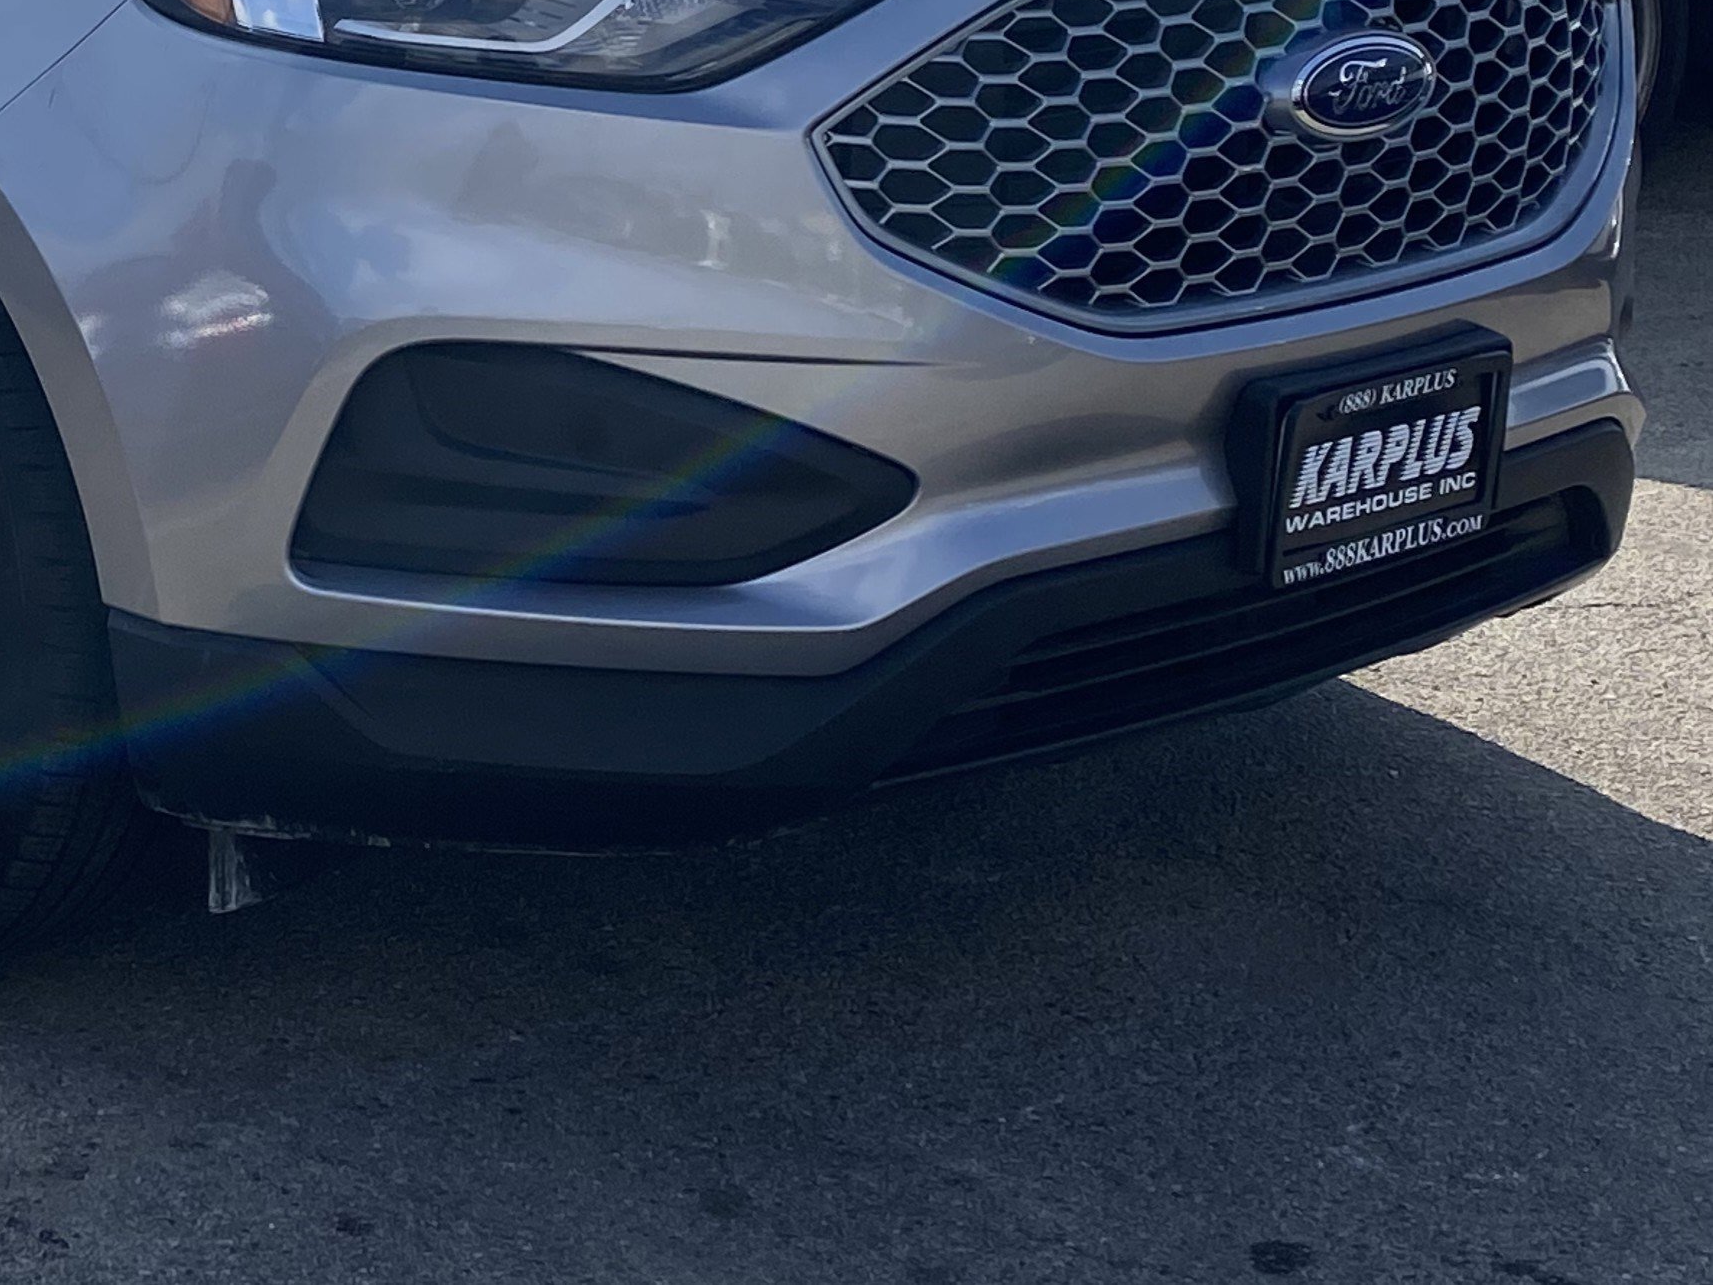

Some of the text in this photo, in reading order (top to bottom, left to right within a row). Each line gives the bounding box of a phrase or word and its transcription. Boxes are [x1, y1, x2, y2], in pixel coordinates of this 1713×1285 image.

[1328, 58, 1407, 114] Ford
[1338, 367, 1459, 415] (888) KARPLUS
[1288, 405, 1483, 509] KARPLUS
[1285, 471, 1477, 534] WAREHOUSE INC
